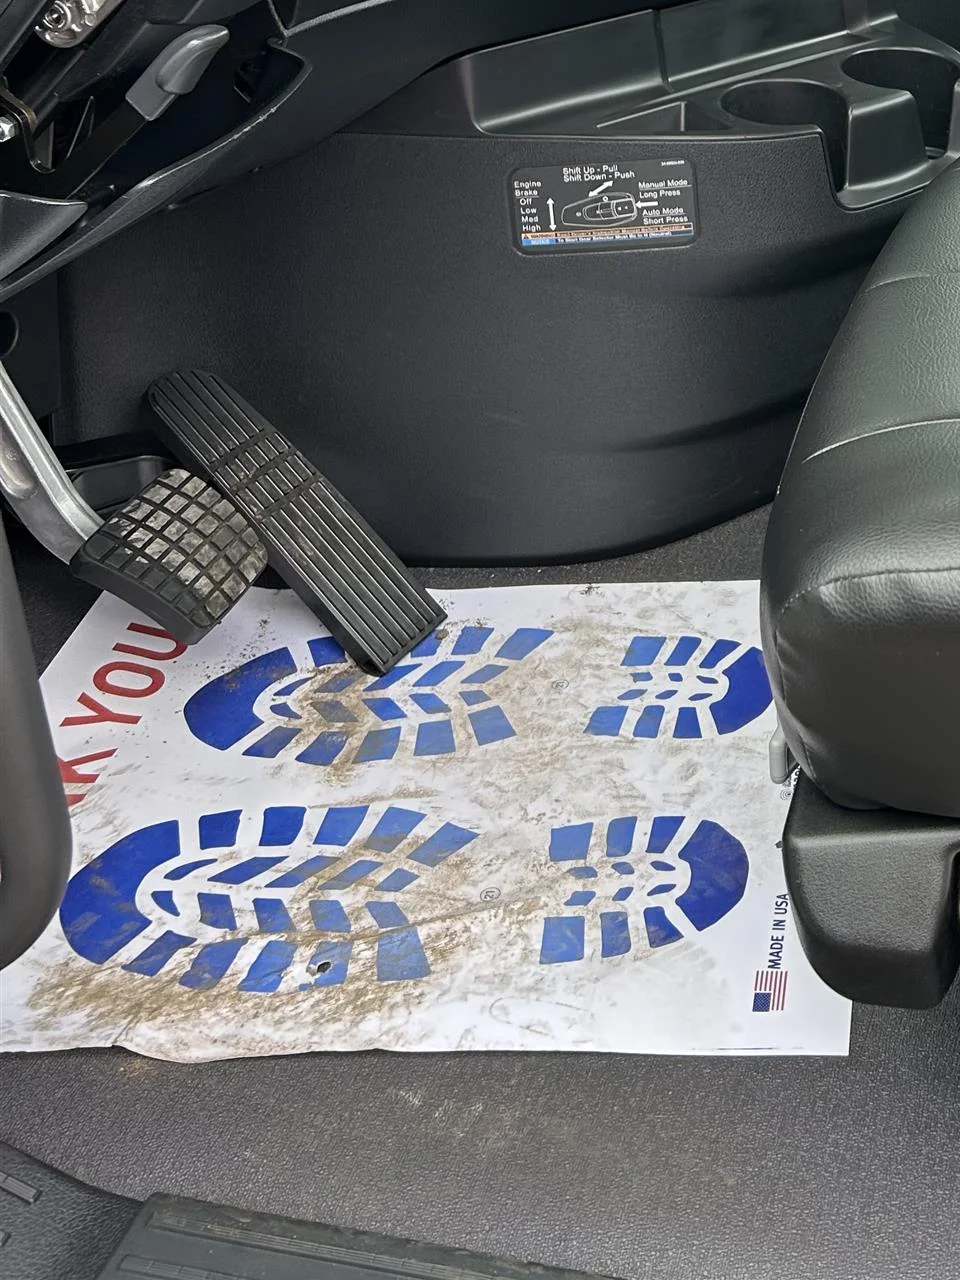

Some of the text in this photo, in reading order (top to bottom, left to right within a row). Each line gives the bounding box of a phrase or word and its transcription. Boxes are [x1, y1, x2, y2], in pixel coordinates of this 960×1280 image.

[563, 166, 581, 175] Shift
[583, 166, 595, 174] Up
[563, 174, 582, 182] Shift
[584, 173, 607, 181] Down
[614, 171, 635, 179] Push
[514, 181, 541, 189] Engine
[638, 179, 688, 188] Manual Mode
[640, 191, 658, 199] Long
[643, 217, 664, 225] Short
[522, 224, 541, 232] High
[59, 622, 188, 727] YOU
[768, 893, 789, 969] MADE IN USA
